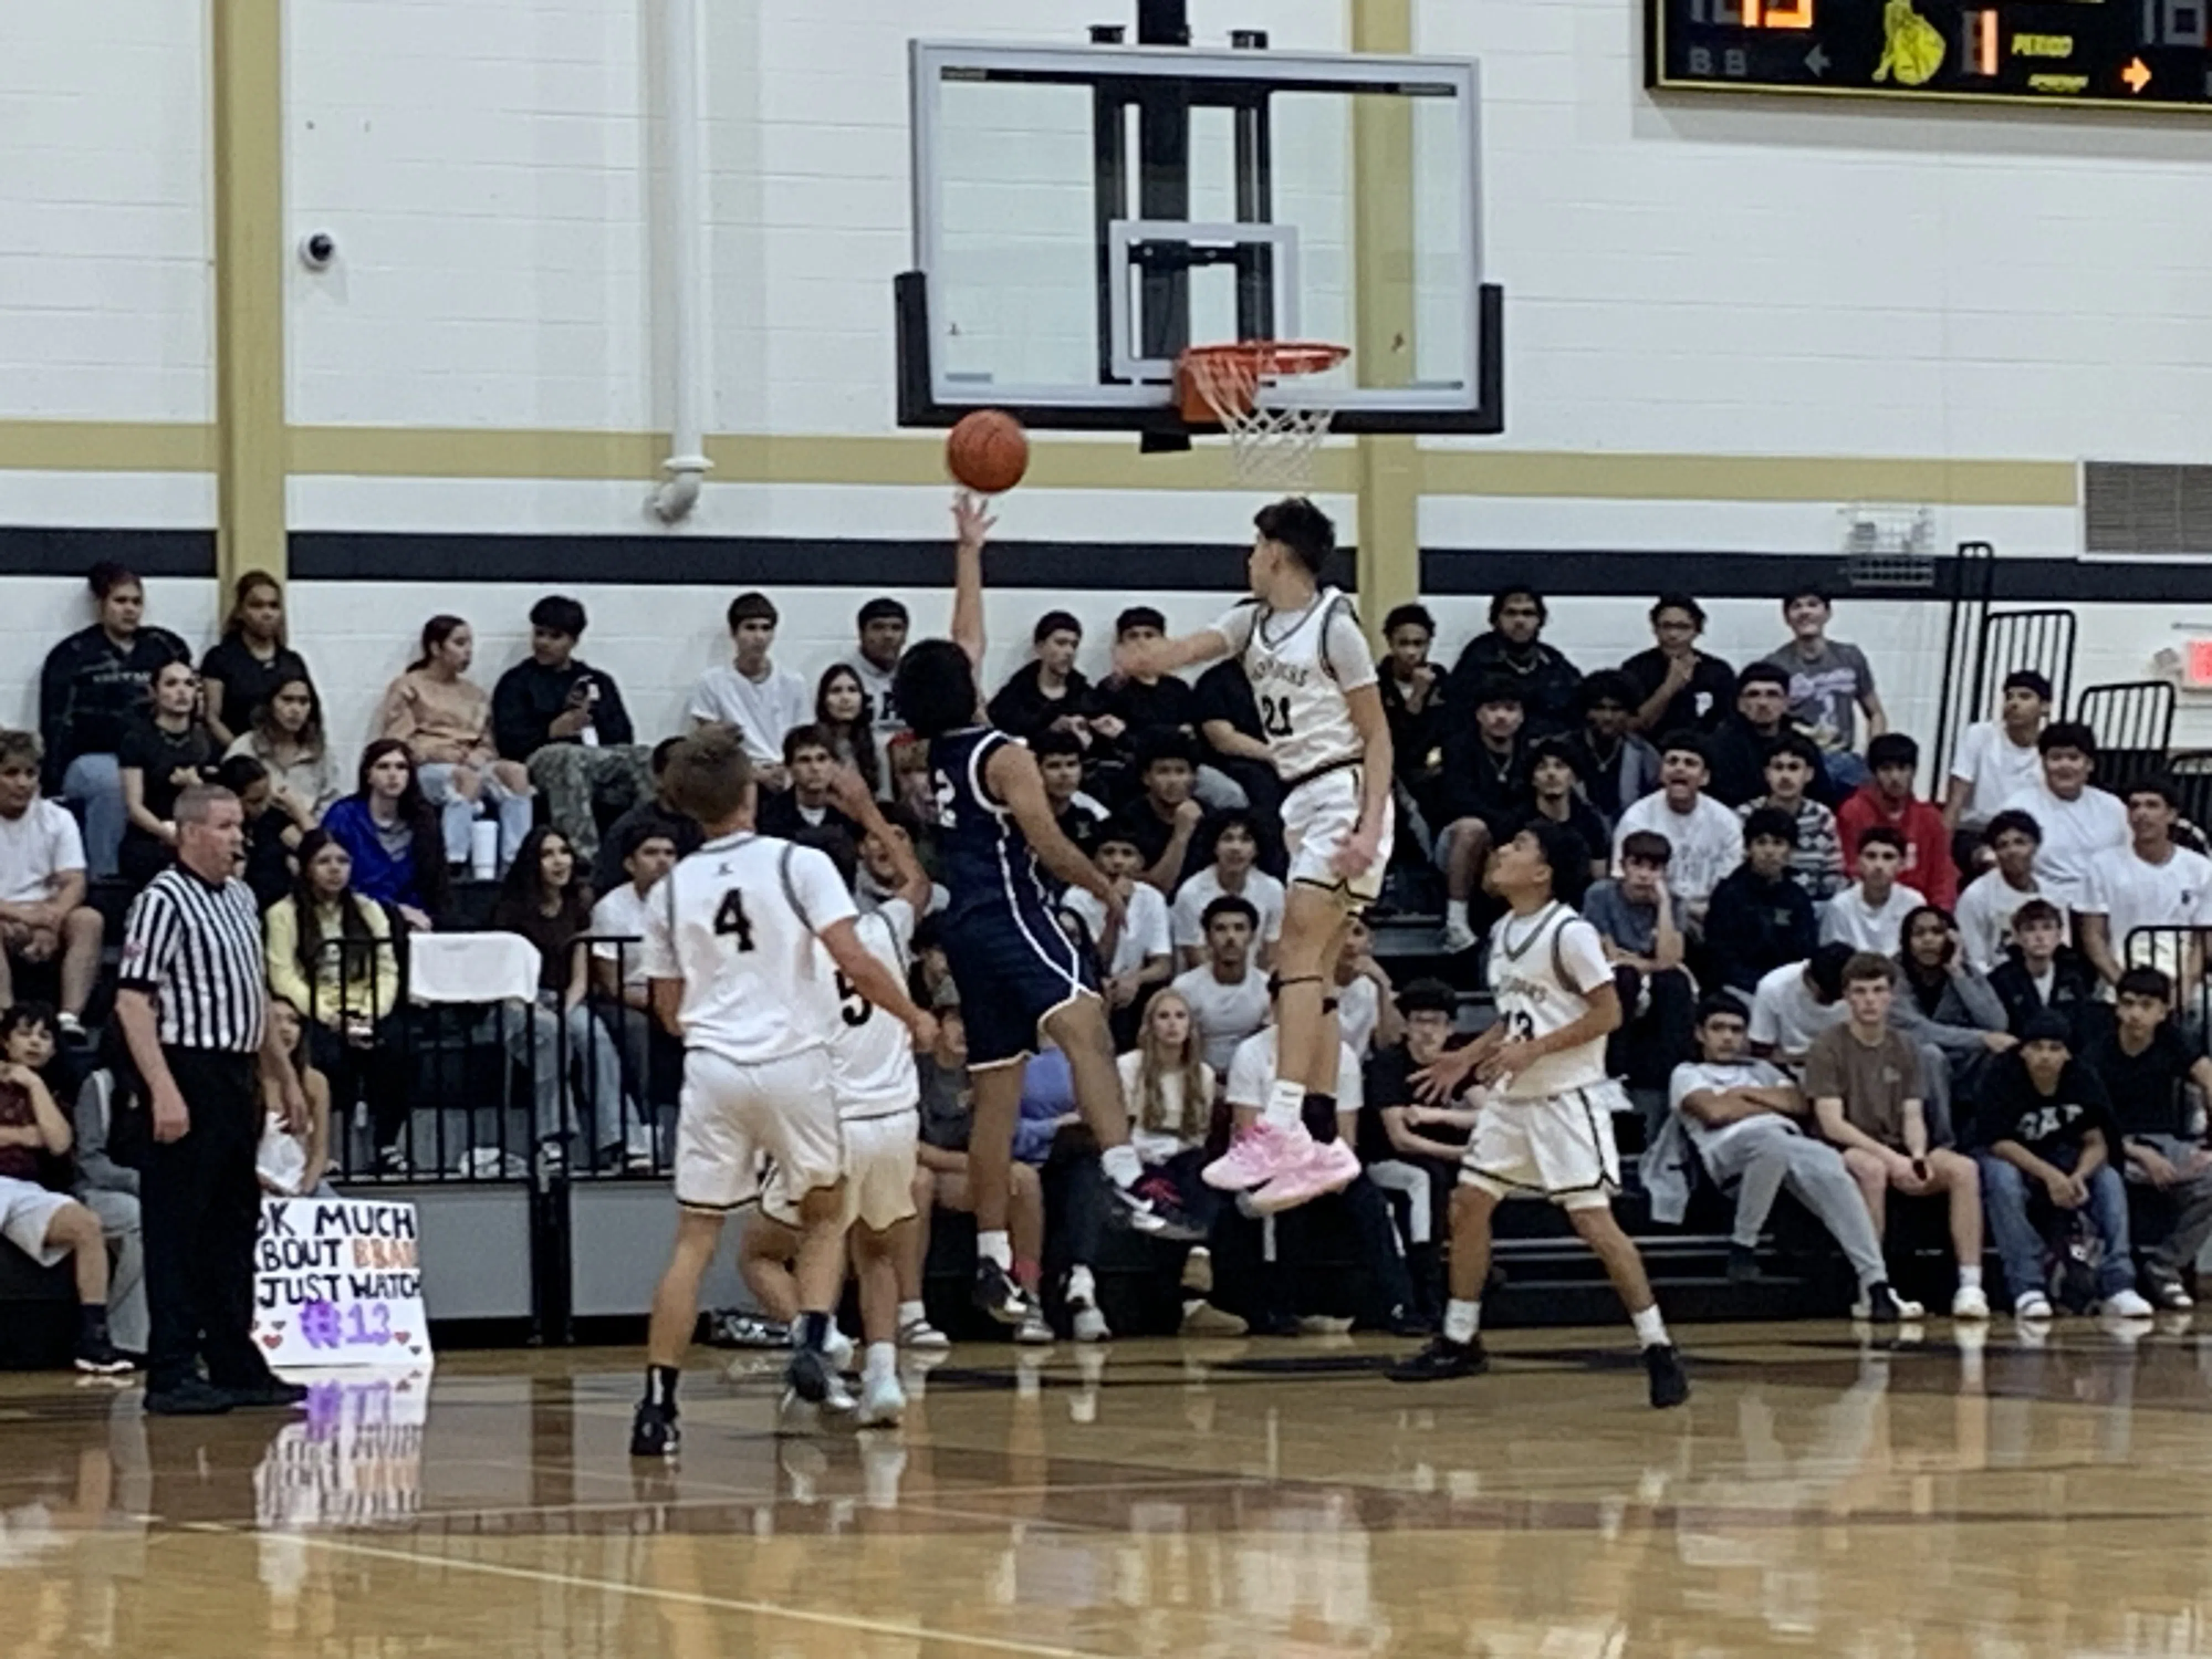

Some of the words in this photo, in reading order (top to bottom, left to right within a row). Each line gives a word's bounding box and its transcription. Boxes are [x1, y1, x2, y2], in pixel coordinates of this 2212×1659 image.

[1261, 695, 1293, 736] 21
[714, 887, 755, 952] 4
[834, 968, 872, 1026] 5
[314, 1204, 415, 1239] MUCH
[257, 1273, 342, 1308] JUST
